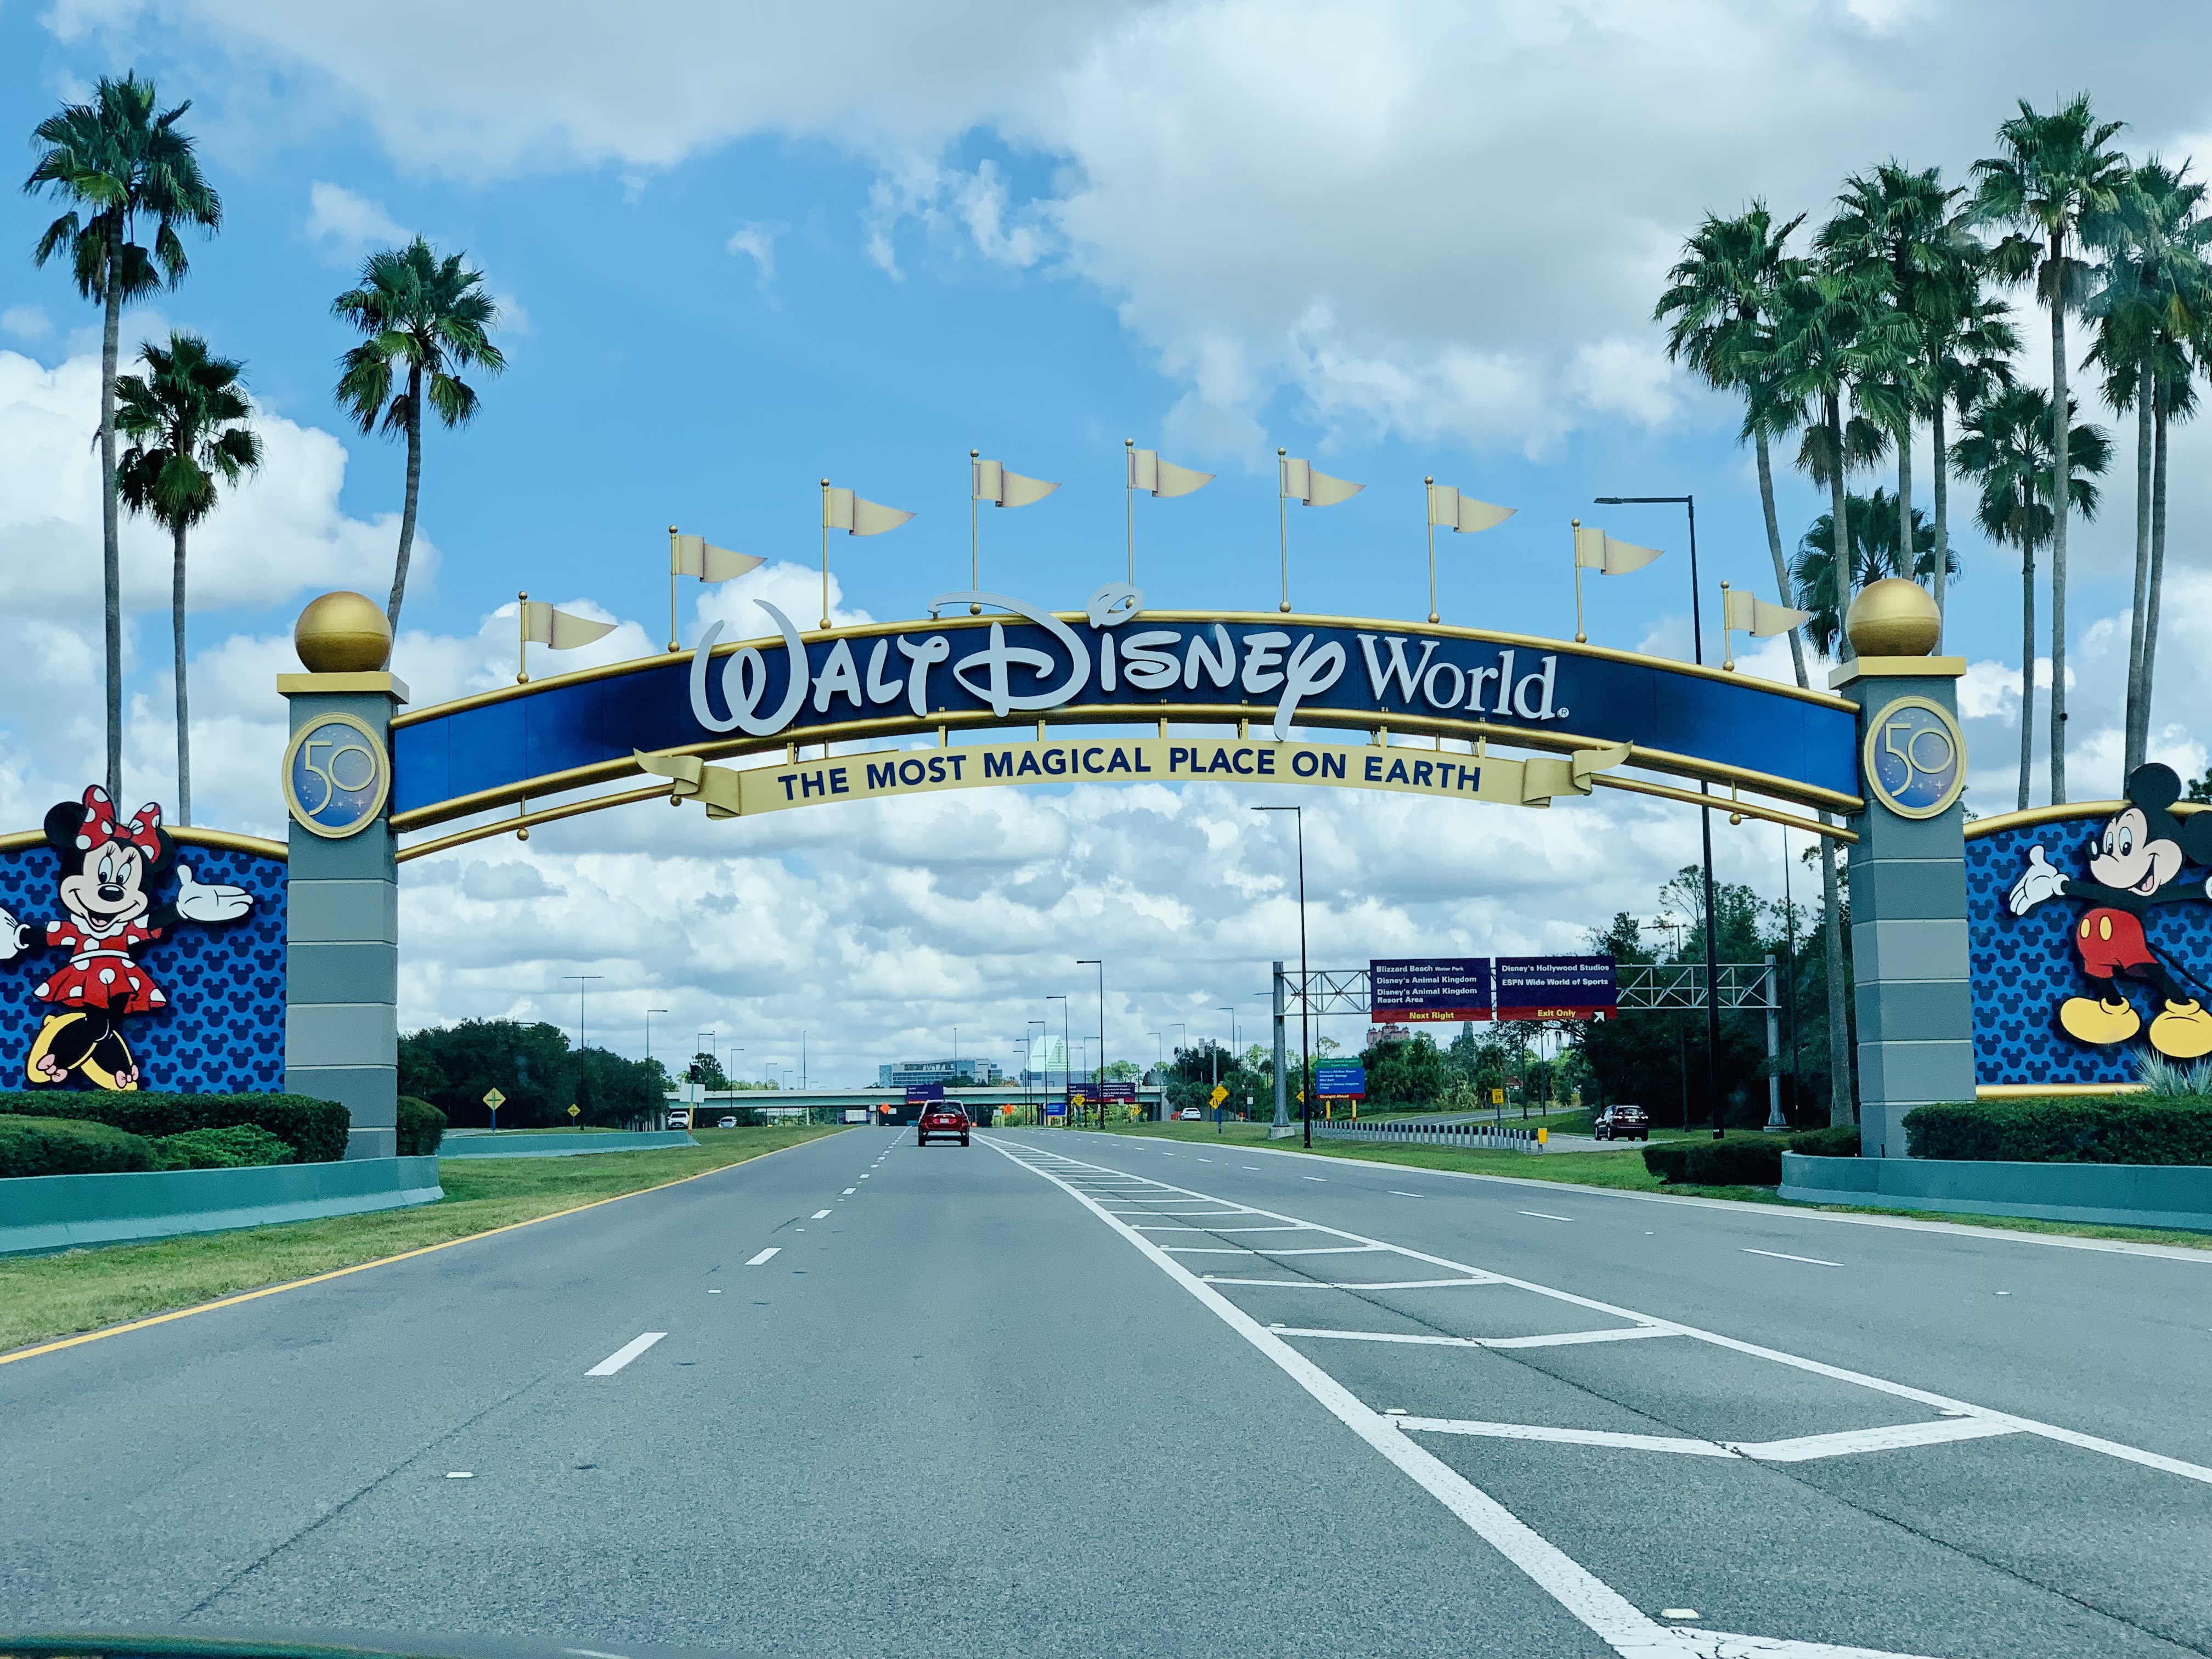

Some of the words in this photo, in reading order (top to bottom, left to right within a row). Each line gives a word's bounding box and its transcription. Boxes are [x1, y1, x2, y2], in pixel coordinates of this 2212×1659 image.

[1886, 723, 1954, 797] 50
[778, 768, 849, 800] THE
[867, 755, 966, 789] MOST
[984, 747, 1151, 777] MAGICAL
[1170, 747, 1275, 775] PLACE
[1292, 751, 1346, 778] ON
[1364, 756, 1480, 792] EARTH
[305, 741, 376, 816] 50
[1536, 964, 1578, 973] Hollywood
[1376, 977, 1410, 985] Disney's
[1442, 976, 1477, 984] Kingdom
[1442, 988, 1477, 996] Kingdom
[1431, 1011, 1455, 1020] Right
[1556, 1009, 1576, 1018] Only
